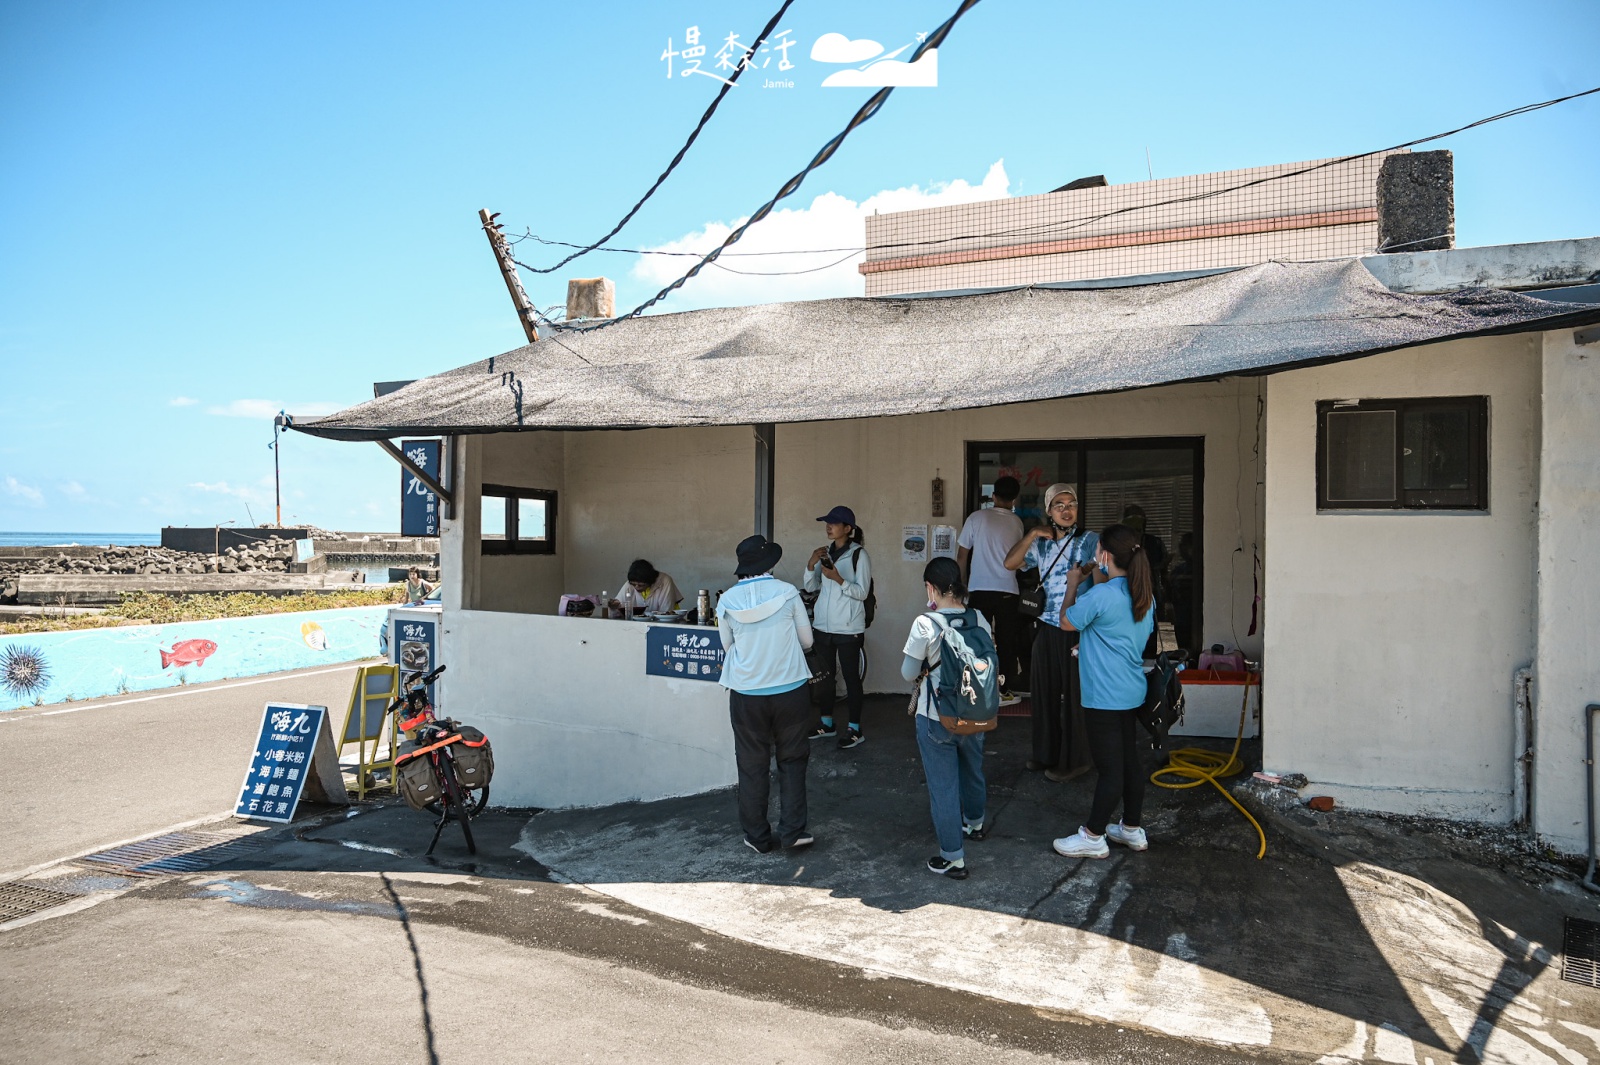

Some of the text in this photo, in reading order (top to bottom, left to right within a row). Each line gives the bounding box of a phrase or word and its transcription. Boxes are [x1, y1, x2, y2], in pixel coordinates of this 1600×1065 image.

[402, 623, 427, 638] 嗨九
[676, 633, 701, 648] 嗨九
[270, 710, 311, 734] 嗨九
[258, 765, 300, 781] 海鮮麵
[252, 782, 294, 798] 滷鮑魚
[248, 798, 289, 814] 石花凍
